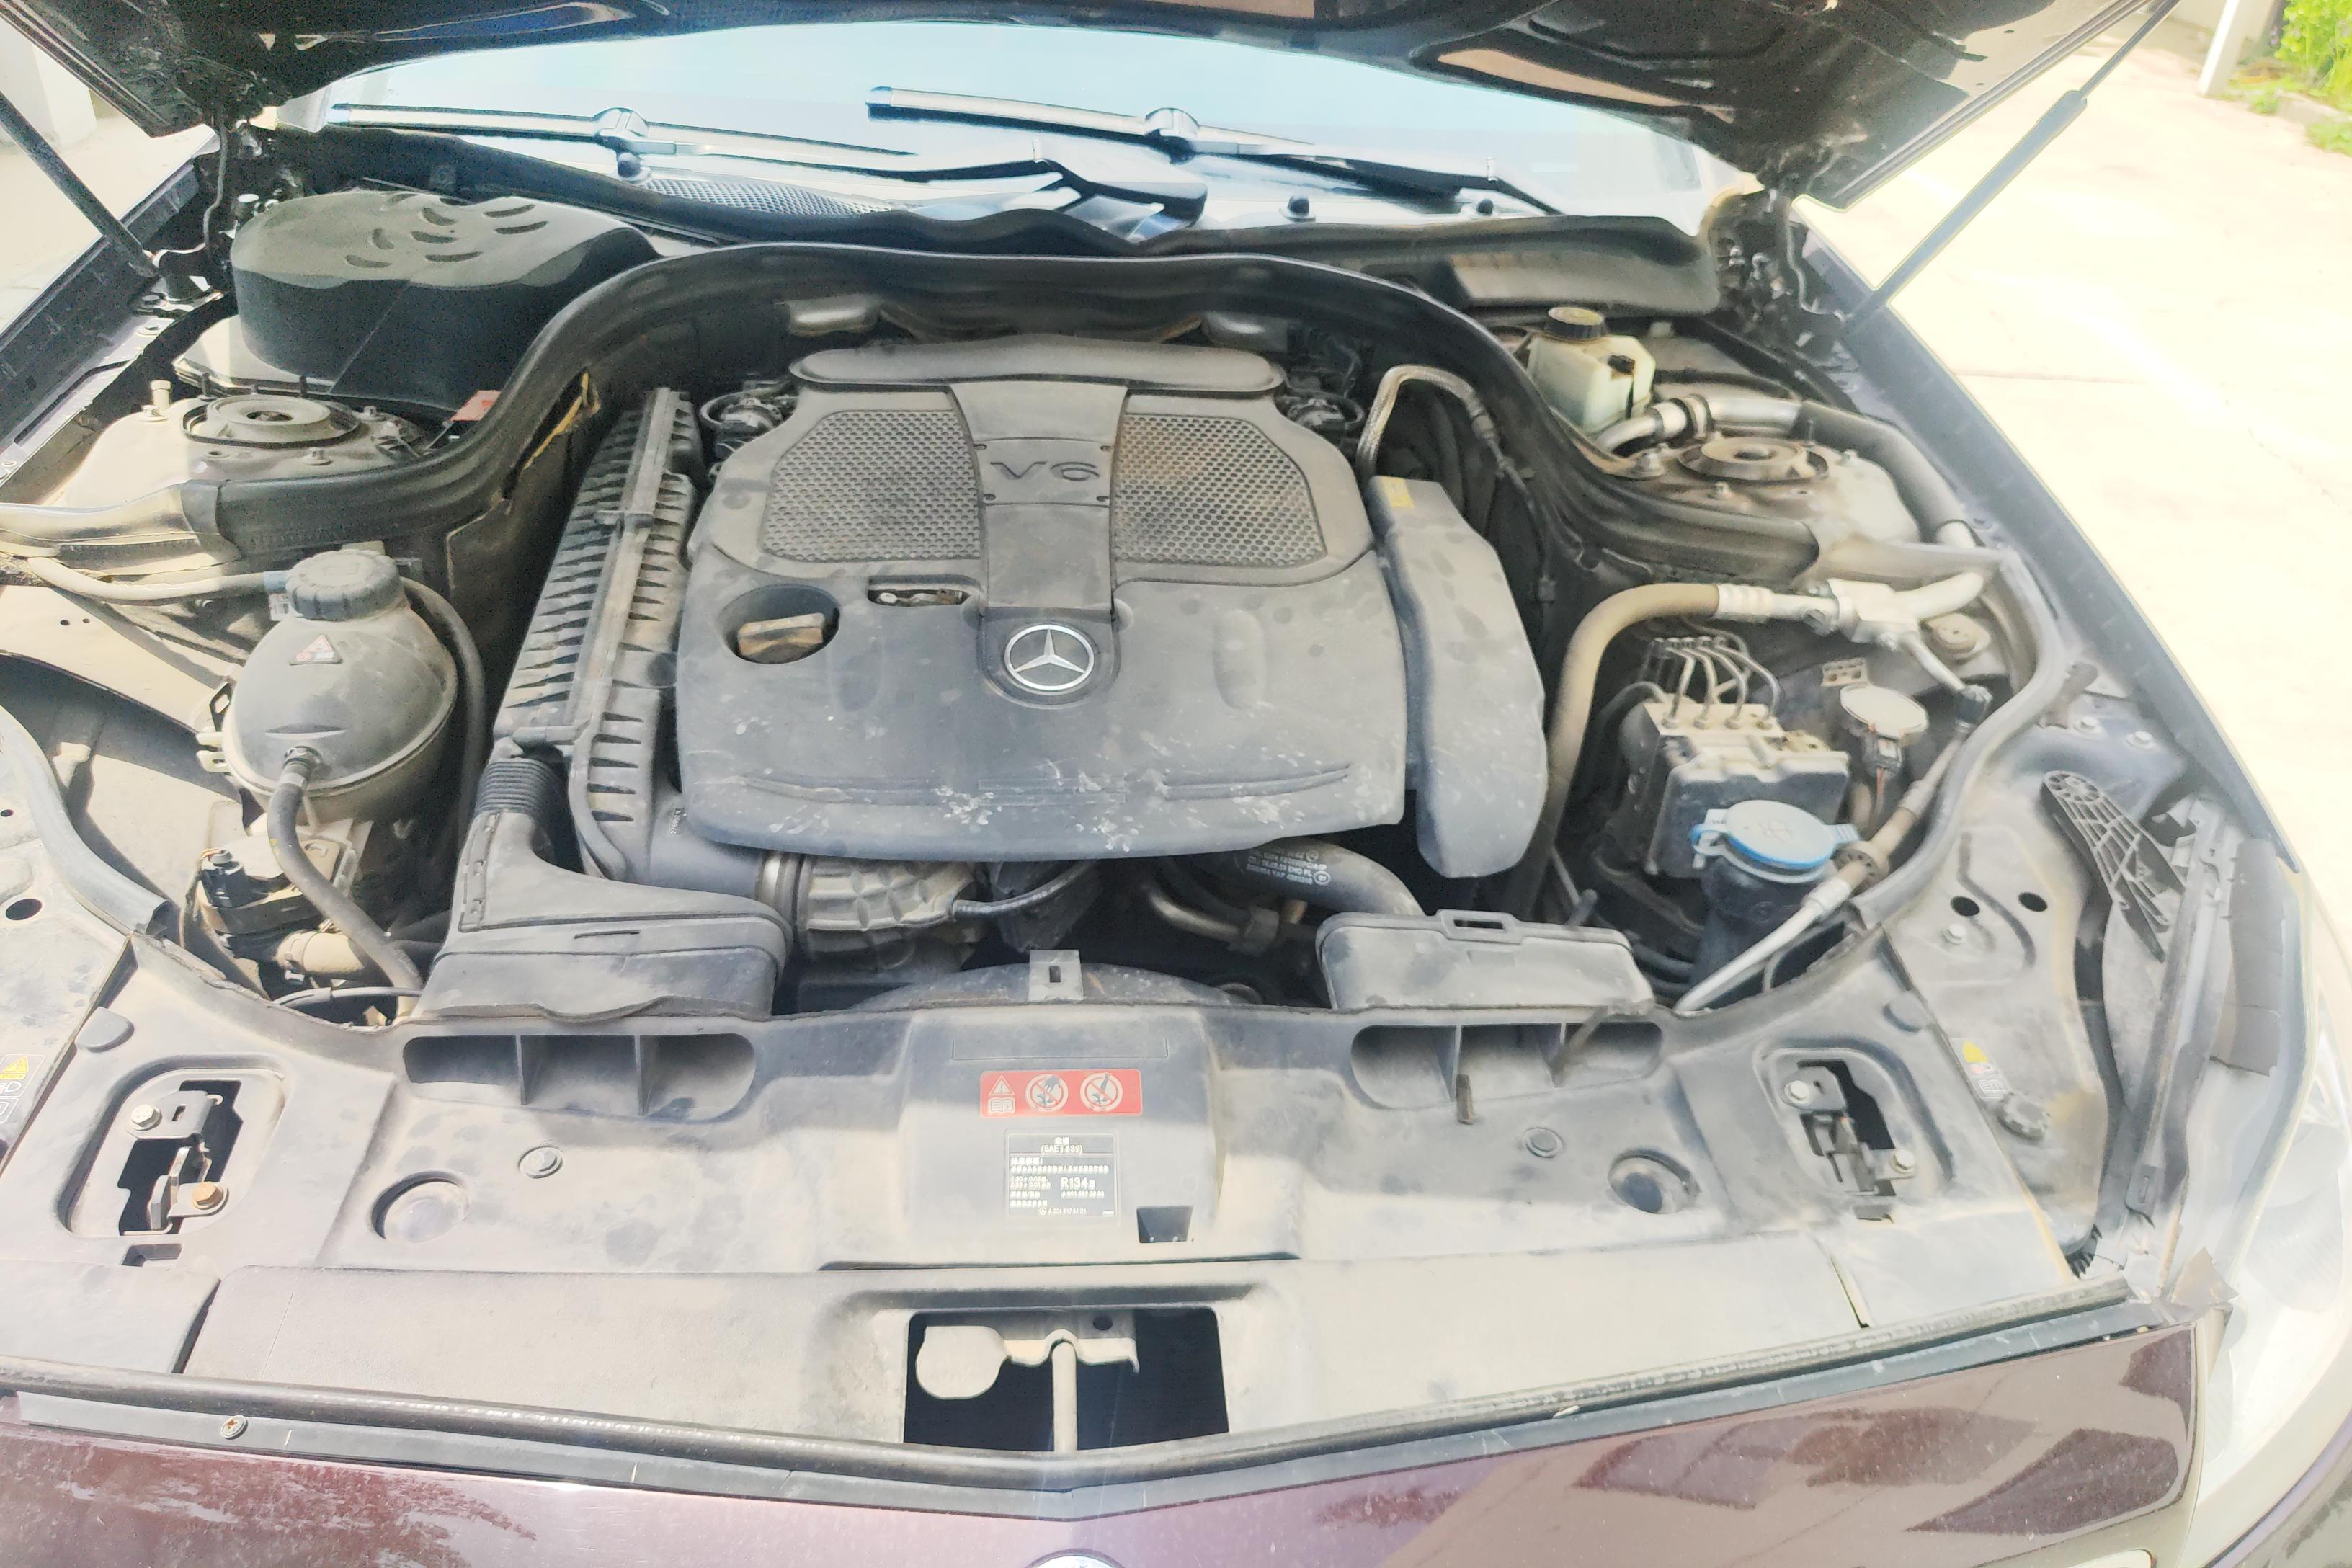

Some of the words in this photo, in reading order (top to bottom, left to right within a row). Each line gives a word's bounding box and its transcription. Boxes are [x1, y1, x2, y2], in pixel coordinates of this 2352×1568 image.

[989, 460, 1100, 482] V6
[1041, 1144, 1059, 1153] (SAE
[1064, 1144, 1083, 1153] 639)
[1061, 1177, 1095, 1189] R134a
